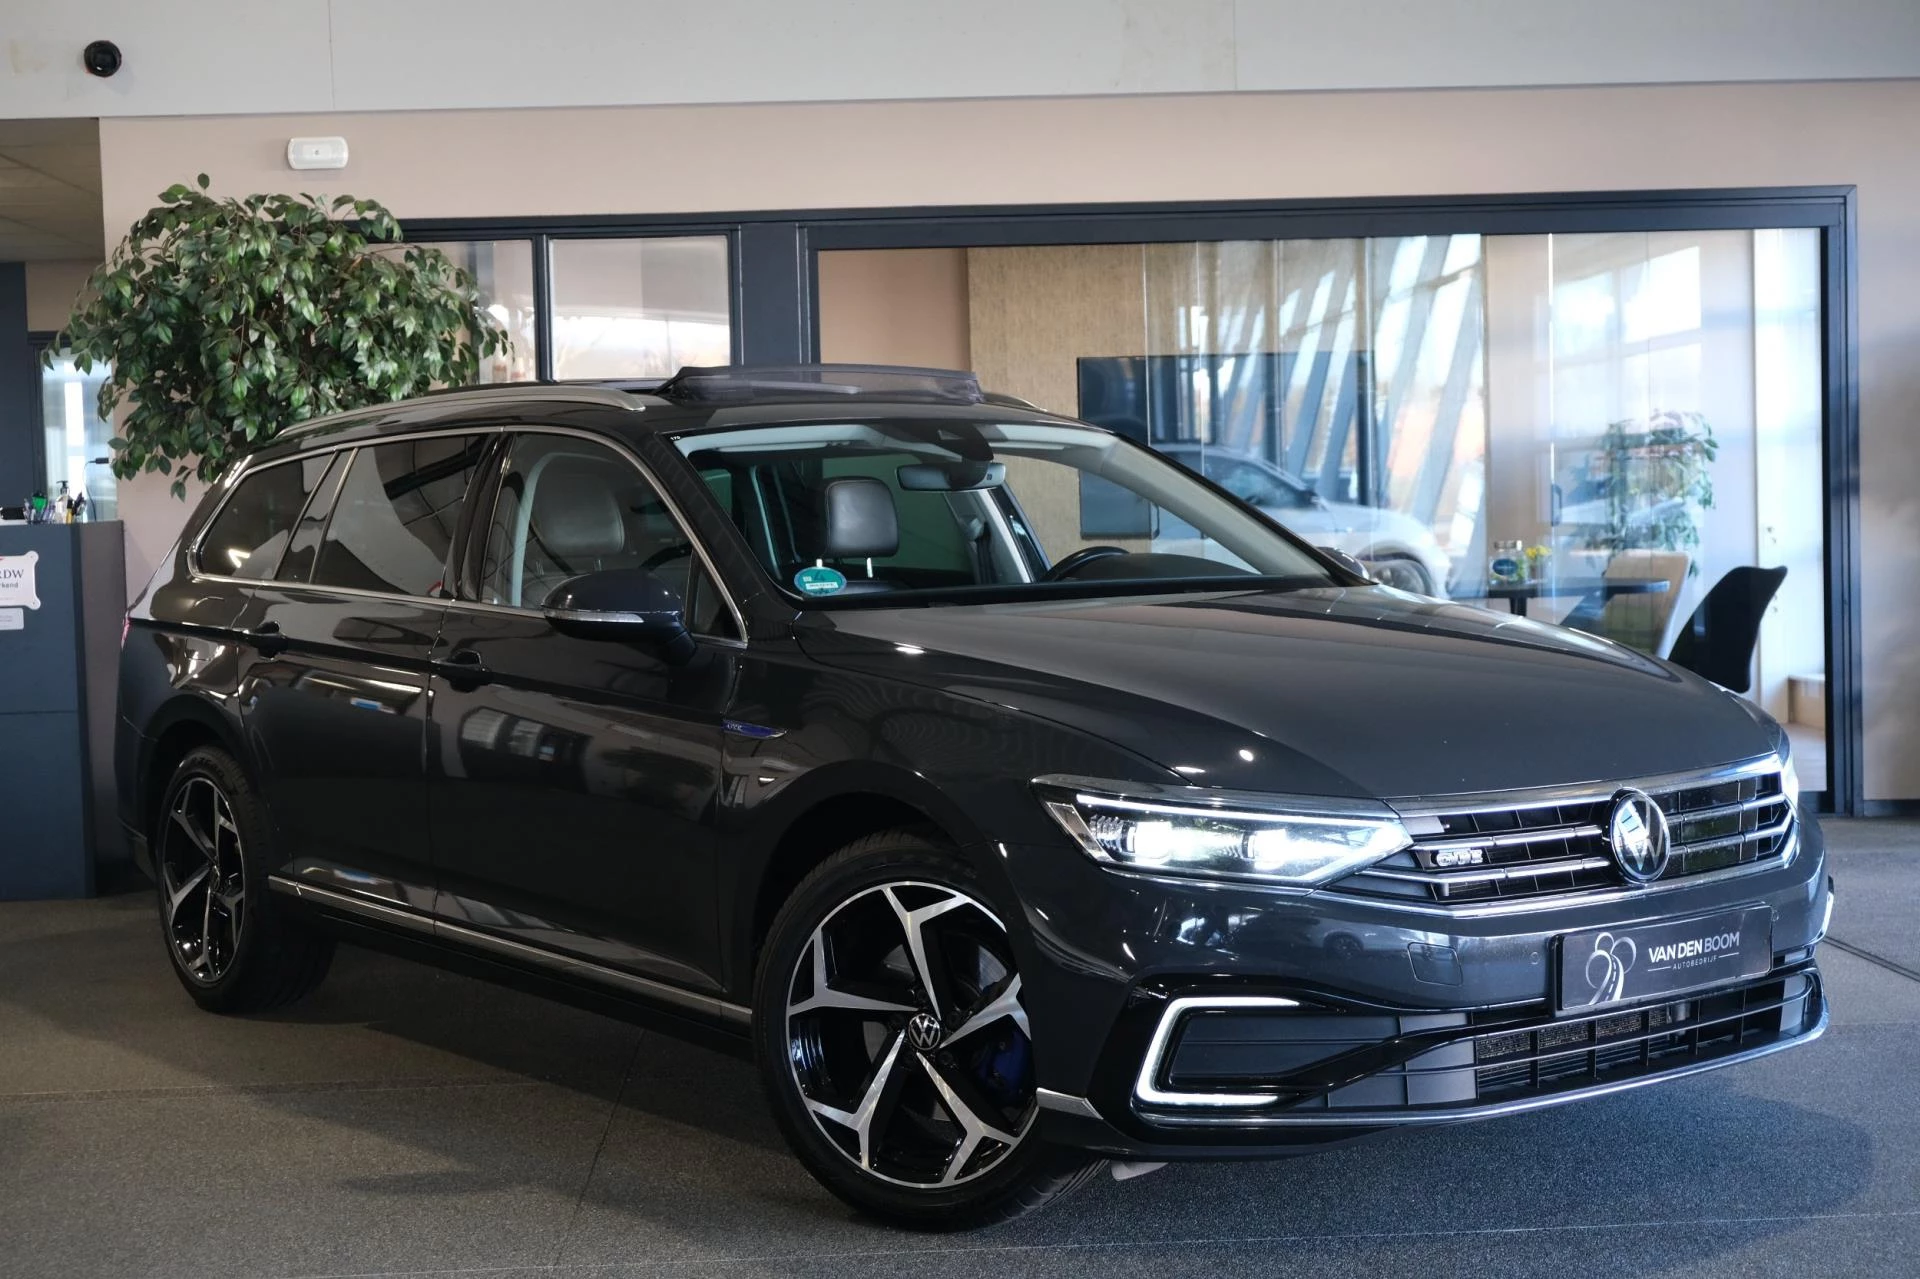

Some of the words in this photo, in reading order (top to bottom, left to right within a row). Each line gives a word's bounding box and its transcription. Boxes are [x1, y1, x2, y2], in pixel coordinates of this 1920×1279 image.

[1648, 943, 1676, 963] VAN
[1677, 938, 1703, 957] DEN
[1704, 931, 1740, 952] BOOM
[1673, 955, 1717, 970] AUTOBEDRIJF
